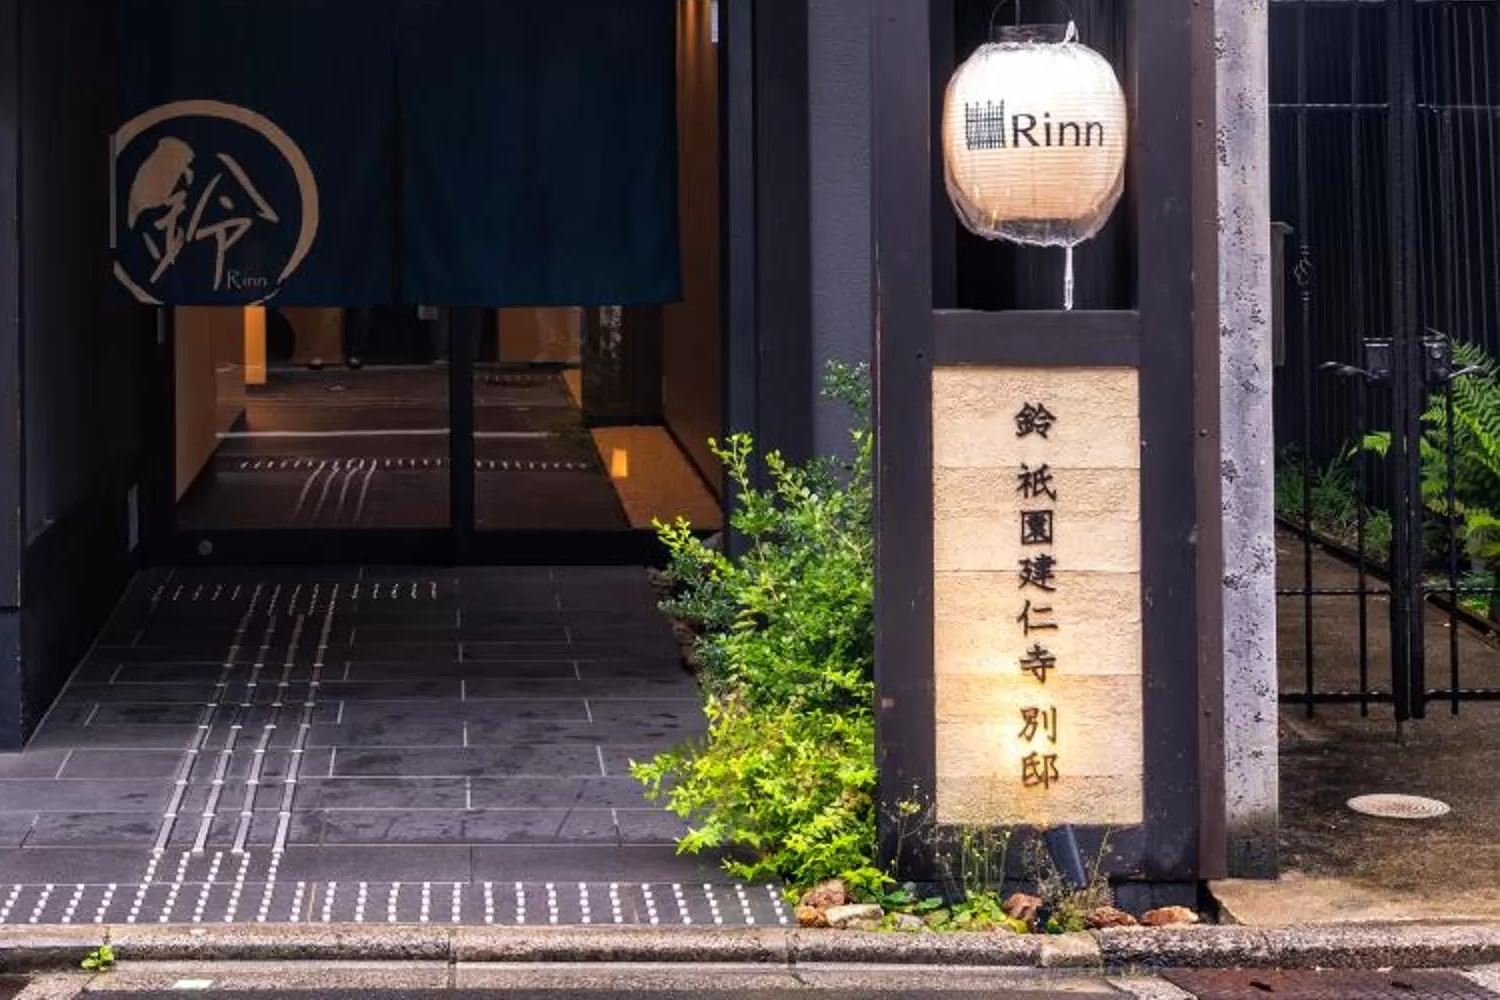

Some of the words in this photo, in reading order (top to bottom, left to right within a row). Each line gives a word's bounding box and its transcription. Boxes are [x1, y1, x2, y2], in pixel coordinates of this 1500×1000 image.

[1011, 111, 1105, 149] Rinn
[226, 270, 268, 290] Rinn
[1013, 401, 1058, 440] 鈴
[1018, 705, 1060, 791] 別邸
